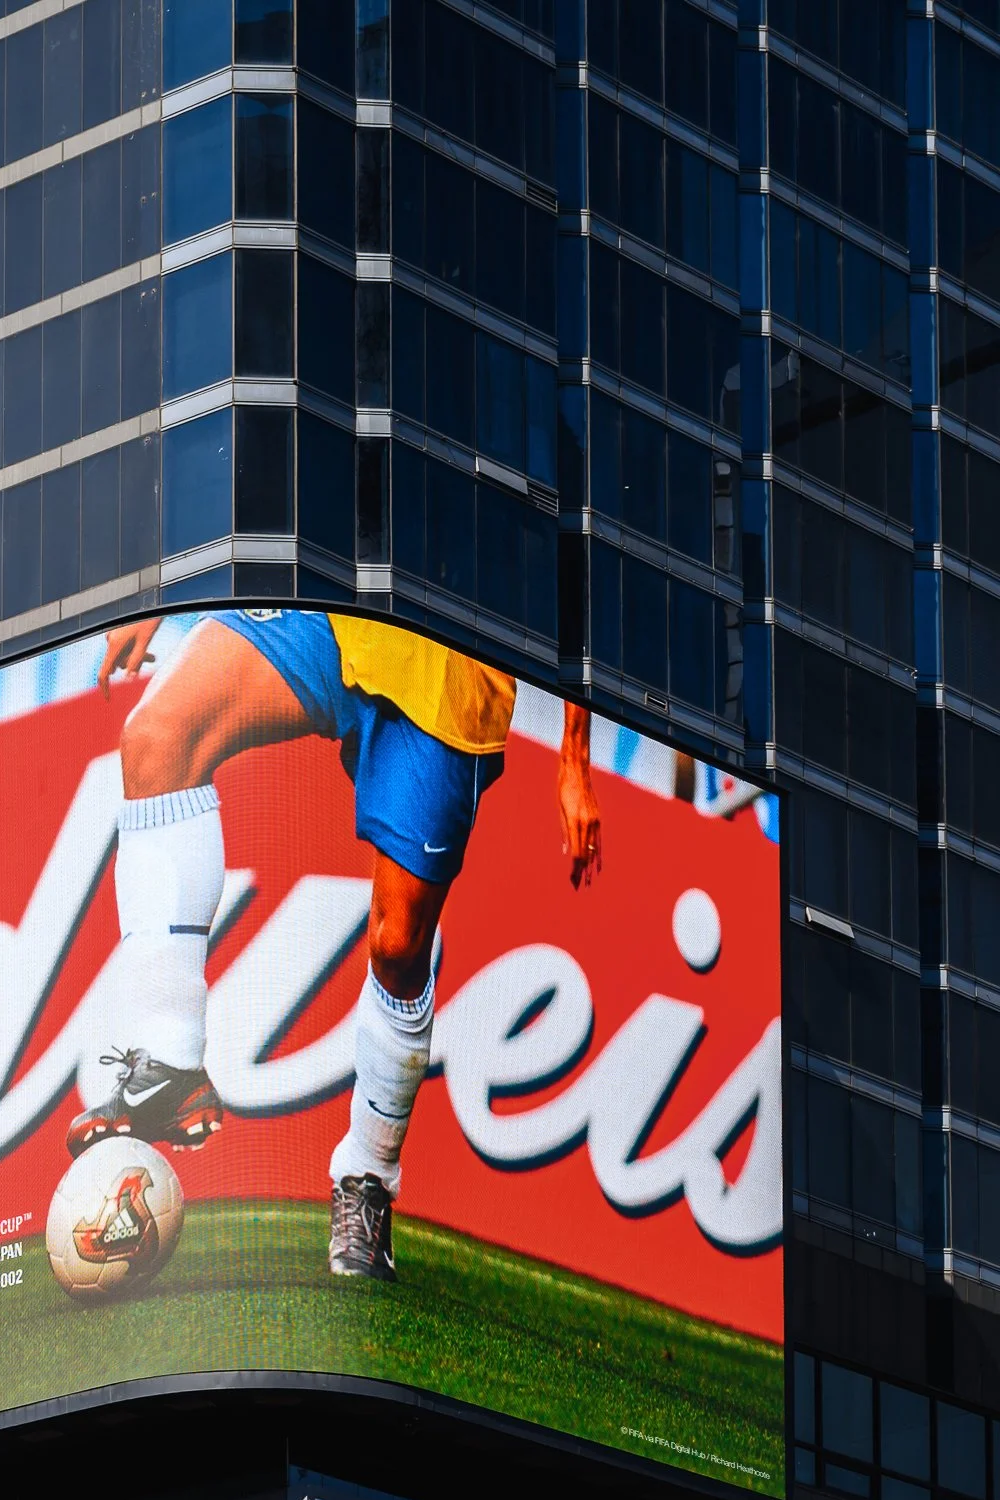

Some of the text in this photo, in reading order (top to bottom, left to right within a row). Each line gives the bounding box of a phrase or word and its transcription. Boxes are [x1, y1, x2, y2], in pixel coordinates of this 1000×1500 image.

[104, 1224, 139, 1243] adidas
[628, 1428, 644, 1440] FIFA
[644, 1434, 654, 1443] via
[654, 1436, 670, 1448] FIFA
[671, 1441, 691, 1455] Digital
[691, 1447, 706, 1460] Hub
[710, 1454, 736, 1470] Richard
[736, 1462, 771, 1480] Heathcote
